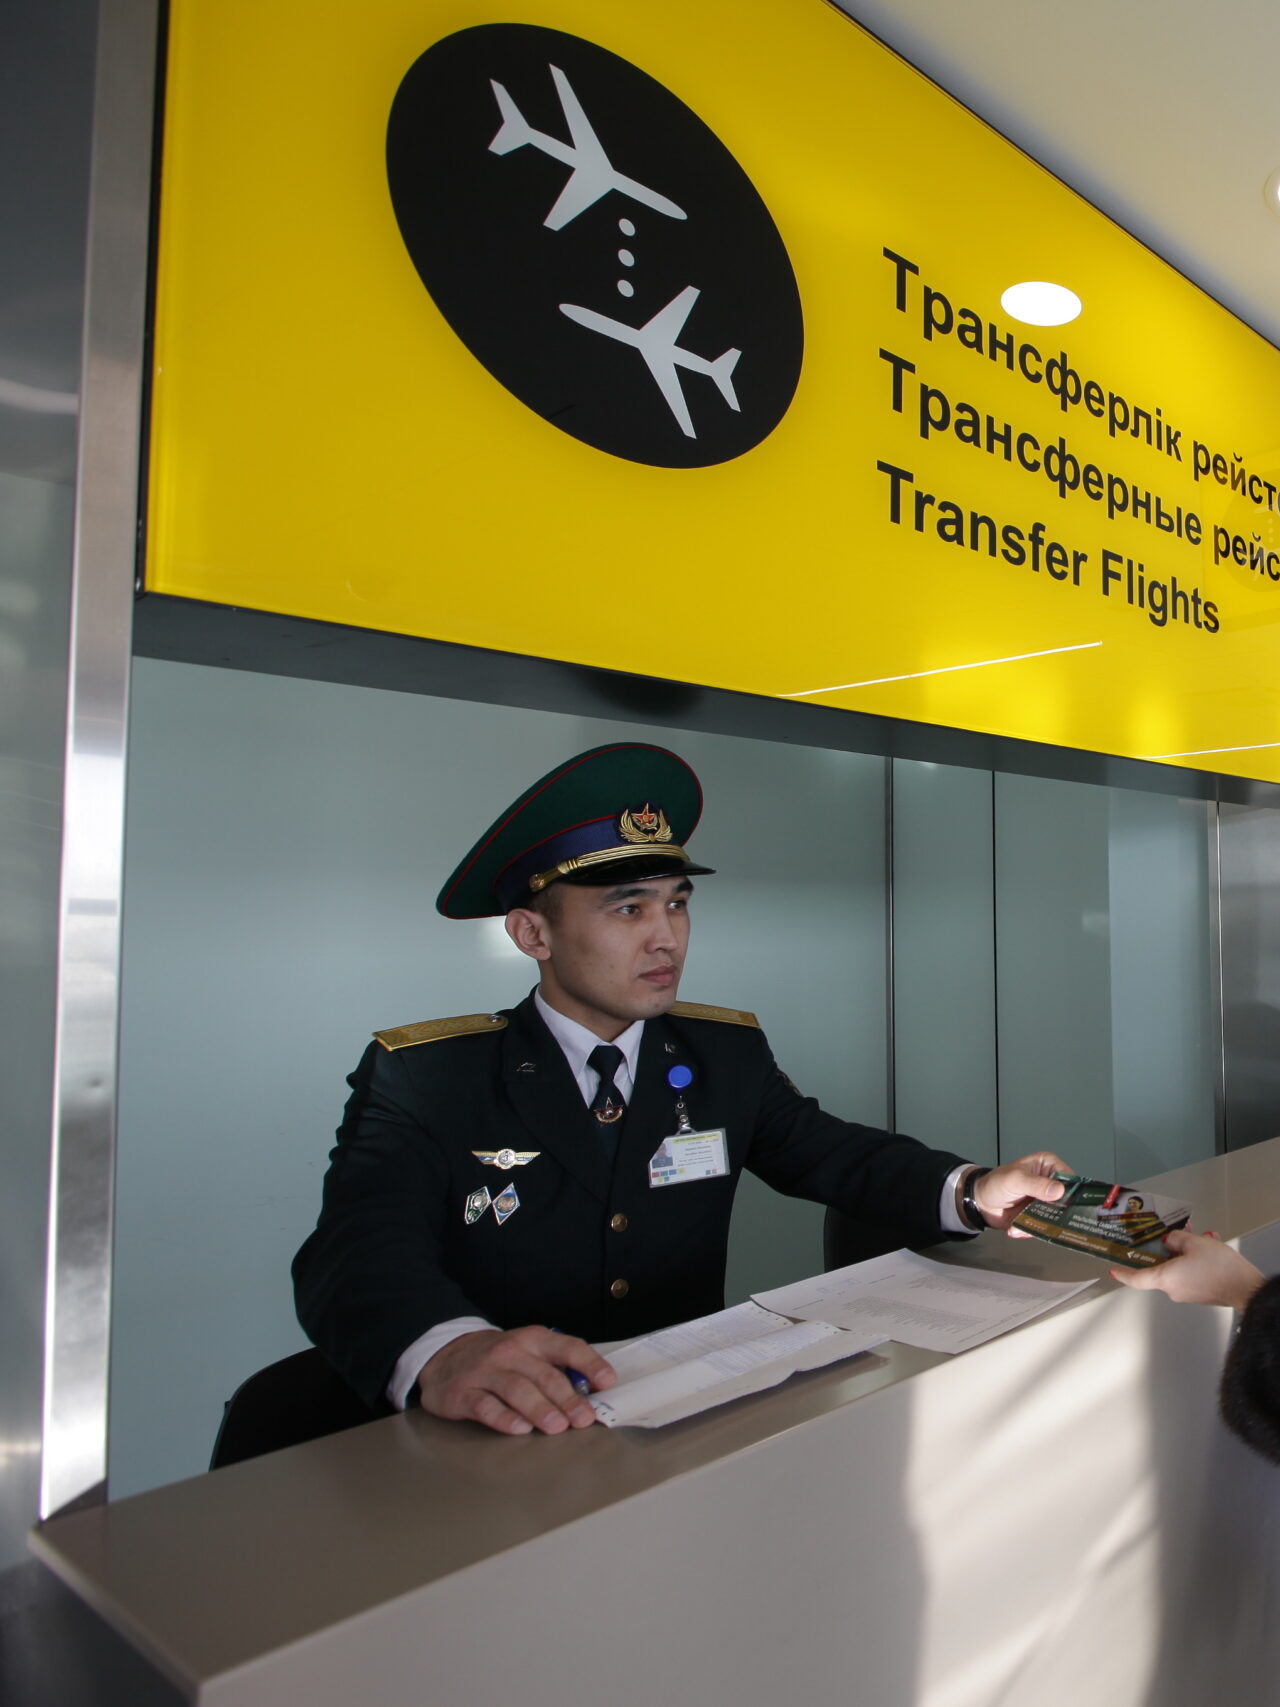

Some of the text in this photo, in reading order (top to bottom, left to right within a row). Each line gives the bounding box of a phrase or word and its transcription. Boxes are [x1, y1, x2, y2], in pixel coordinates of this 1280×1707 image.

[879, 347, 1201, 545] Трансферные
[883, 247, 1182, 461] Трансферлік
[877, 460, 1220, 633] Transfer Flights
